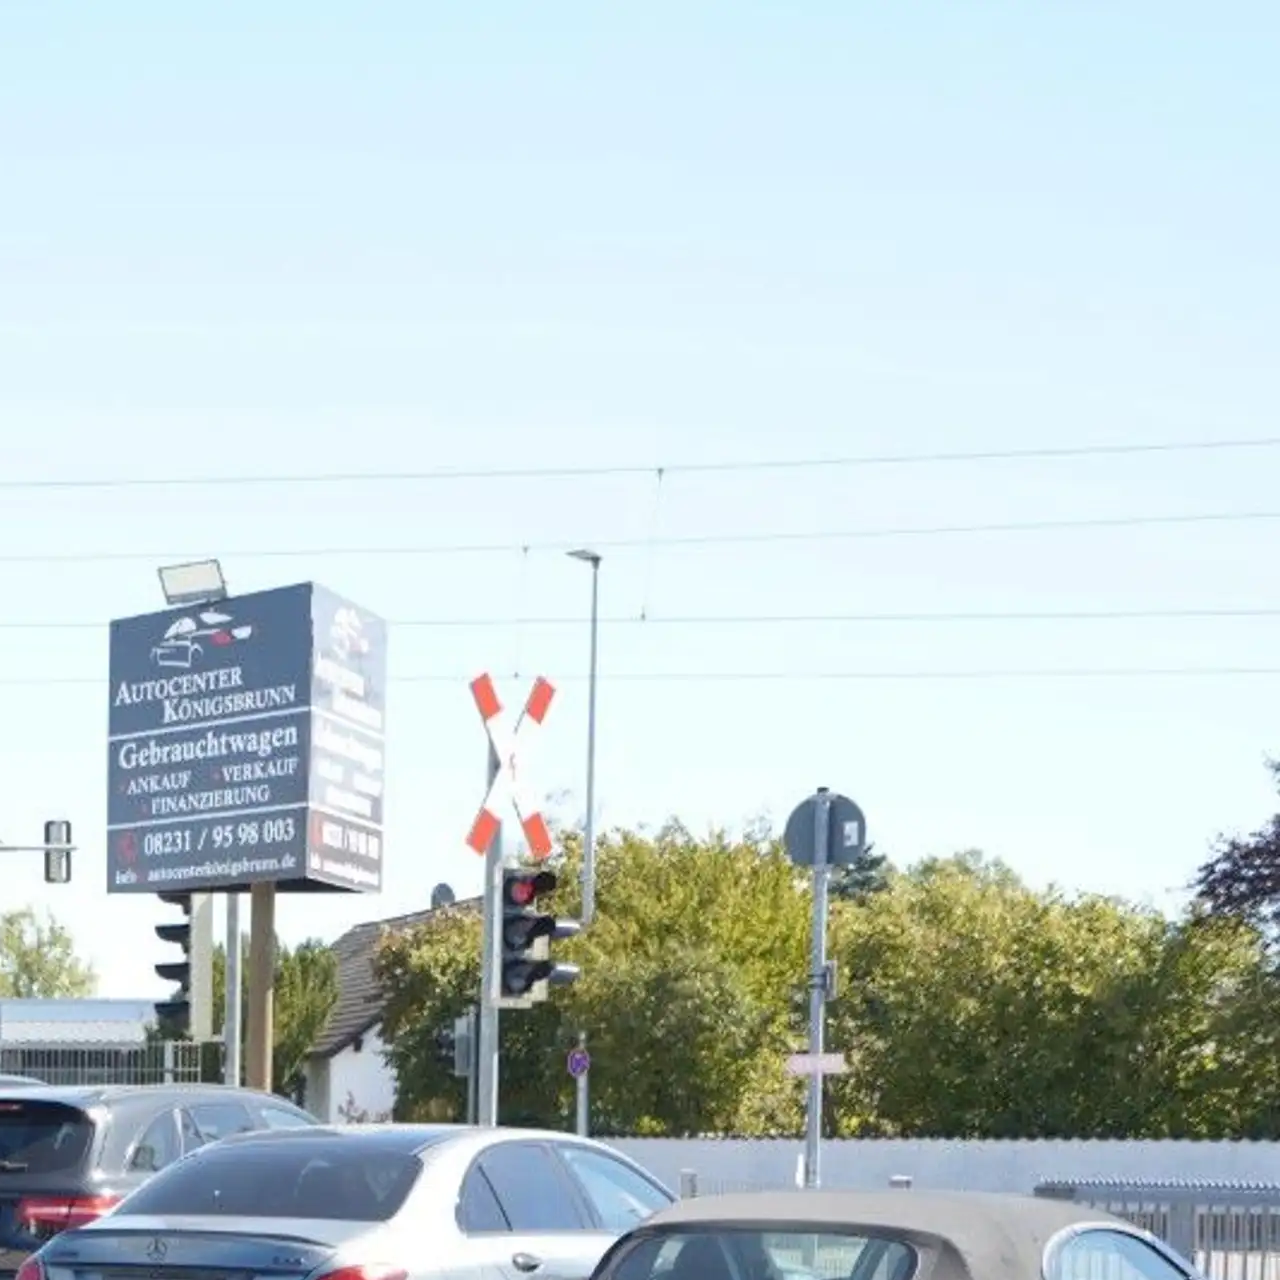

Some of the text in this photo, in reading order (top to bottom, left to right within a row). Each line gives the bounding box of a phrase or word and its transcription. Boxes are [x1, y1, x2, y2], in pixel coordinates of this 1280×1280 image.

[115, 666, 244, 707] AUTOCENTER
[162, 684, 297, 724] KÖNIGSBRUNN
[118, 725, 298, 770] Gebrauchtwagen
[127, 757, 300, 796] ANKAUF VERKAUF
[150, 784, 271, 815] FINANZIERUNG
[143, 830, 191, 857] 08231
[196, 827, 209, 851] /
[212, 824, 234, 849] 95
[237, 820, 260, 846] 98
[262, 816, 296, 844] 003
